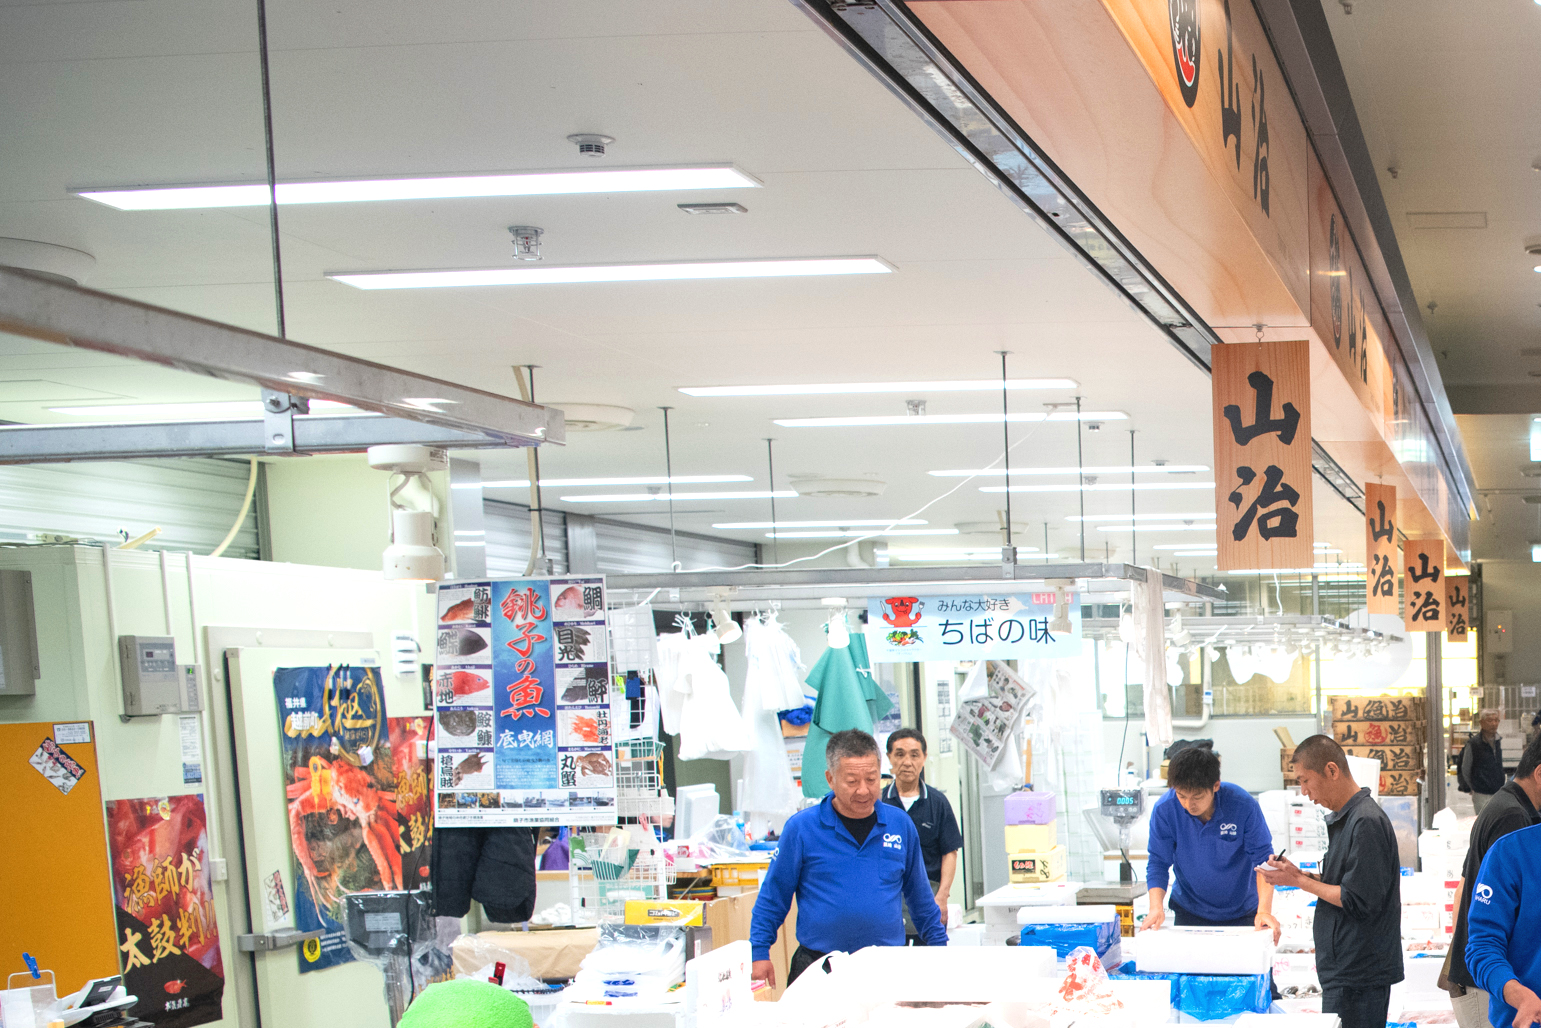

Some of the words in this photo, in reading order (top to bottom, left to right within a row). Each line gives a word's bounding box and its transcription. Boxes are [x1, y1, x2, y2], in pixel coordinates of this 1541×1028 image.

[1218, 0, 1270, 219] 山治
[1347, 265, 1368, 386] 山治
[1223, 371, 1301, 541] 山治
[1369, 500, 1396, 598] 山治
[937, 598, 1010, 612] みんな大好き
[1408, 552, 1441, 623] 山治
[1450, 585, 1467, 636] 山治
[500, 587, 550, 720] 銚子の魚
[557, 628, 576, 661] 目光
[938, 616, 1056, 645] ちばの味
[285, 697, 306, 708] 福井県
[497, 729, 554, 748] 底曳網
[125, 847, 202, 914] 漁師が
